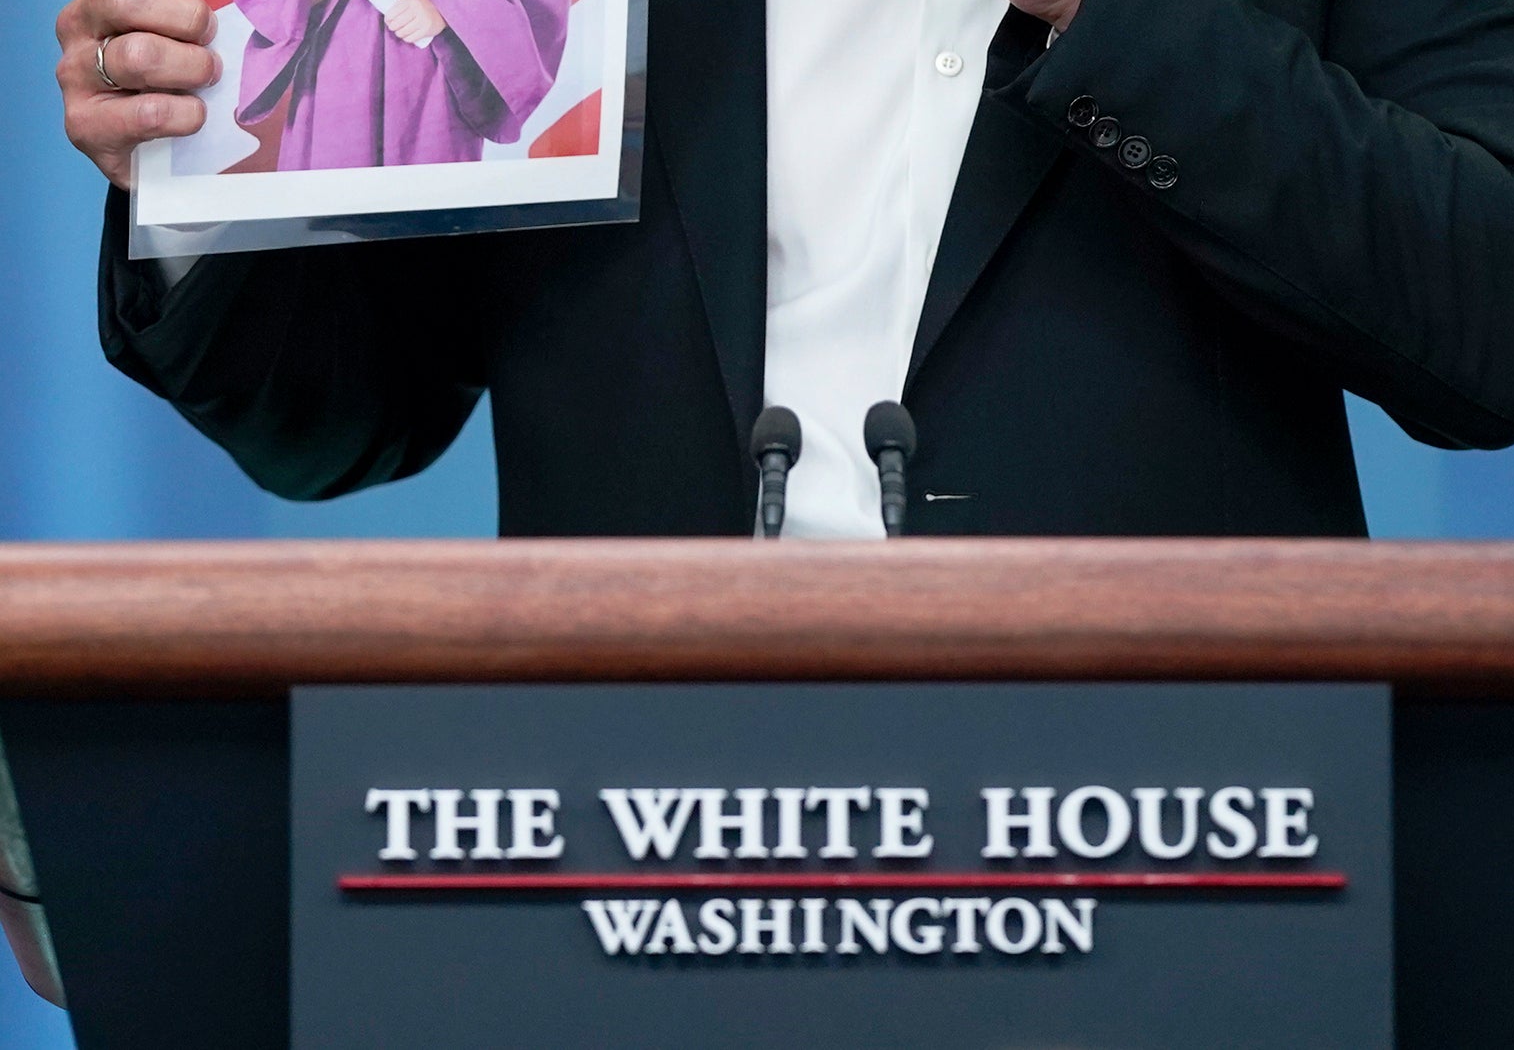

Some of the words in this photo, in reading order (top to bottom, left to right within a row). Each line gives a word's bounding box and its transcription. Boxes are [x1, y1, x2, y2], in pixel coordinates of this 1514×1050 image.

[365, 787, 564, 861] THE
[600, 786, 934, 860] WHITE
[980, 784, 1319, 859] HOUSE
[581, 897, 1098, 955] WASHINGTON
